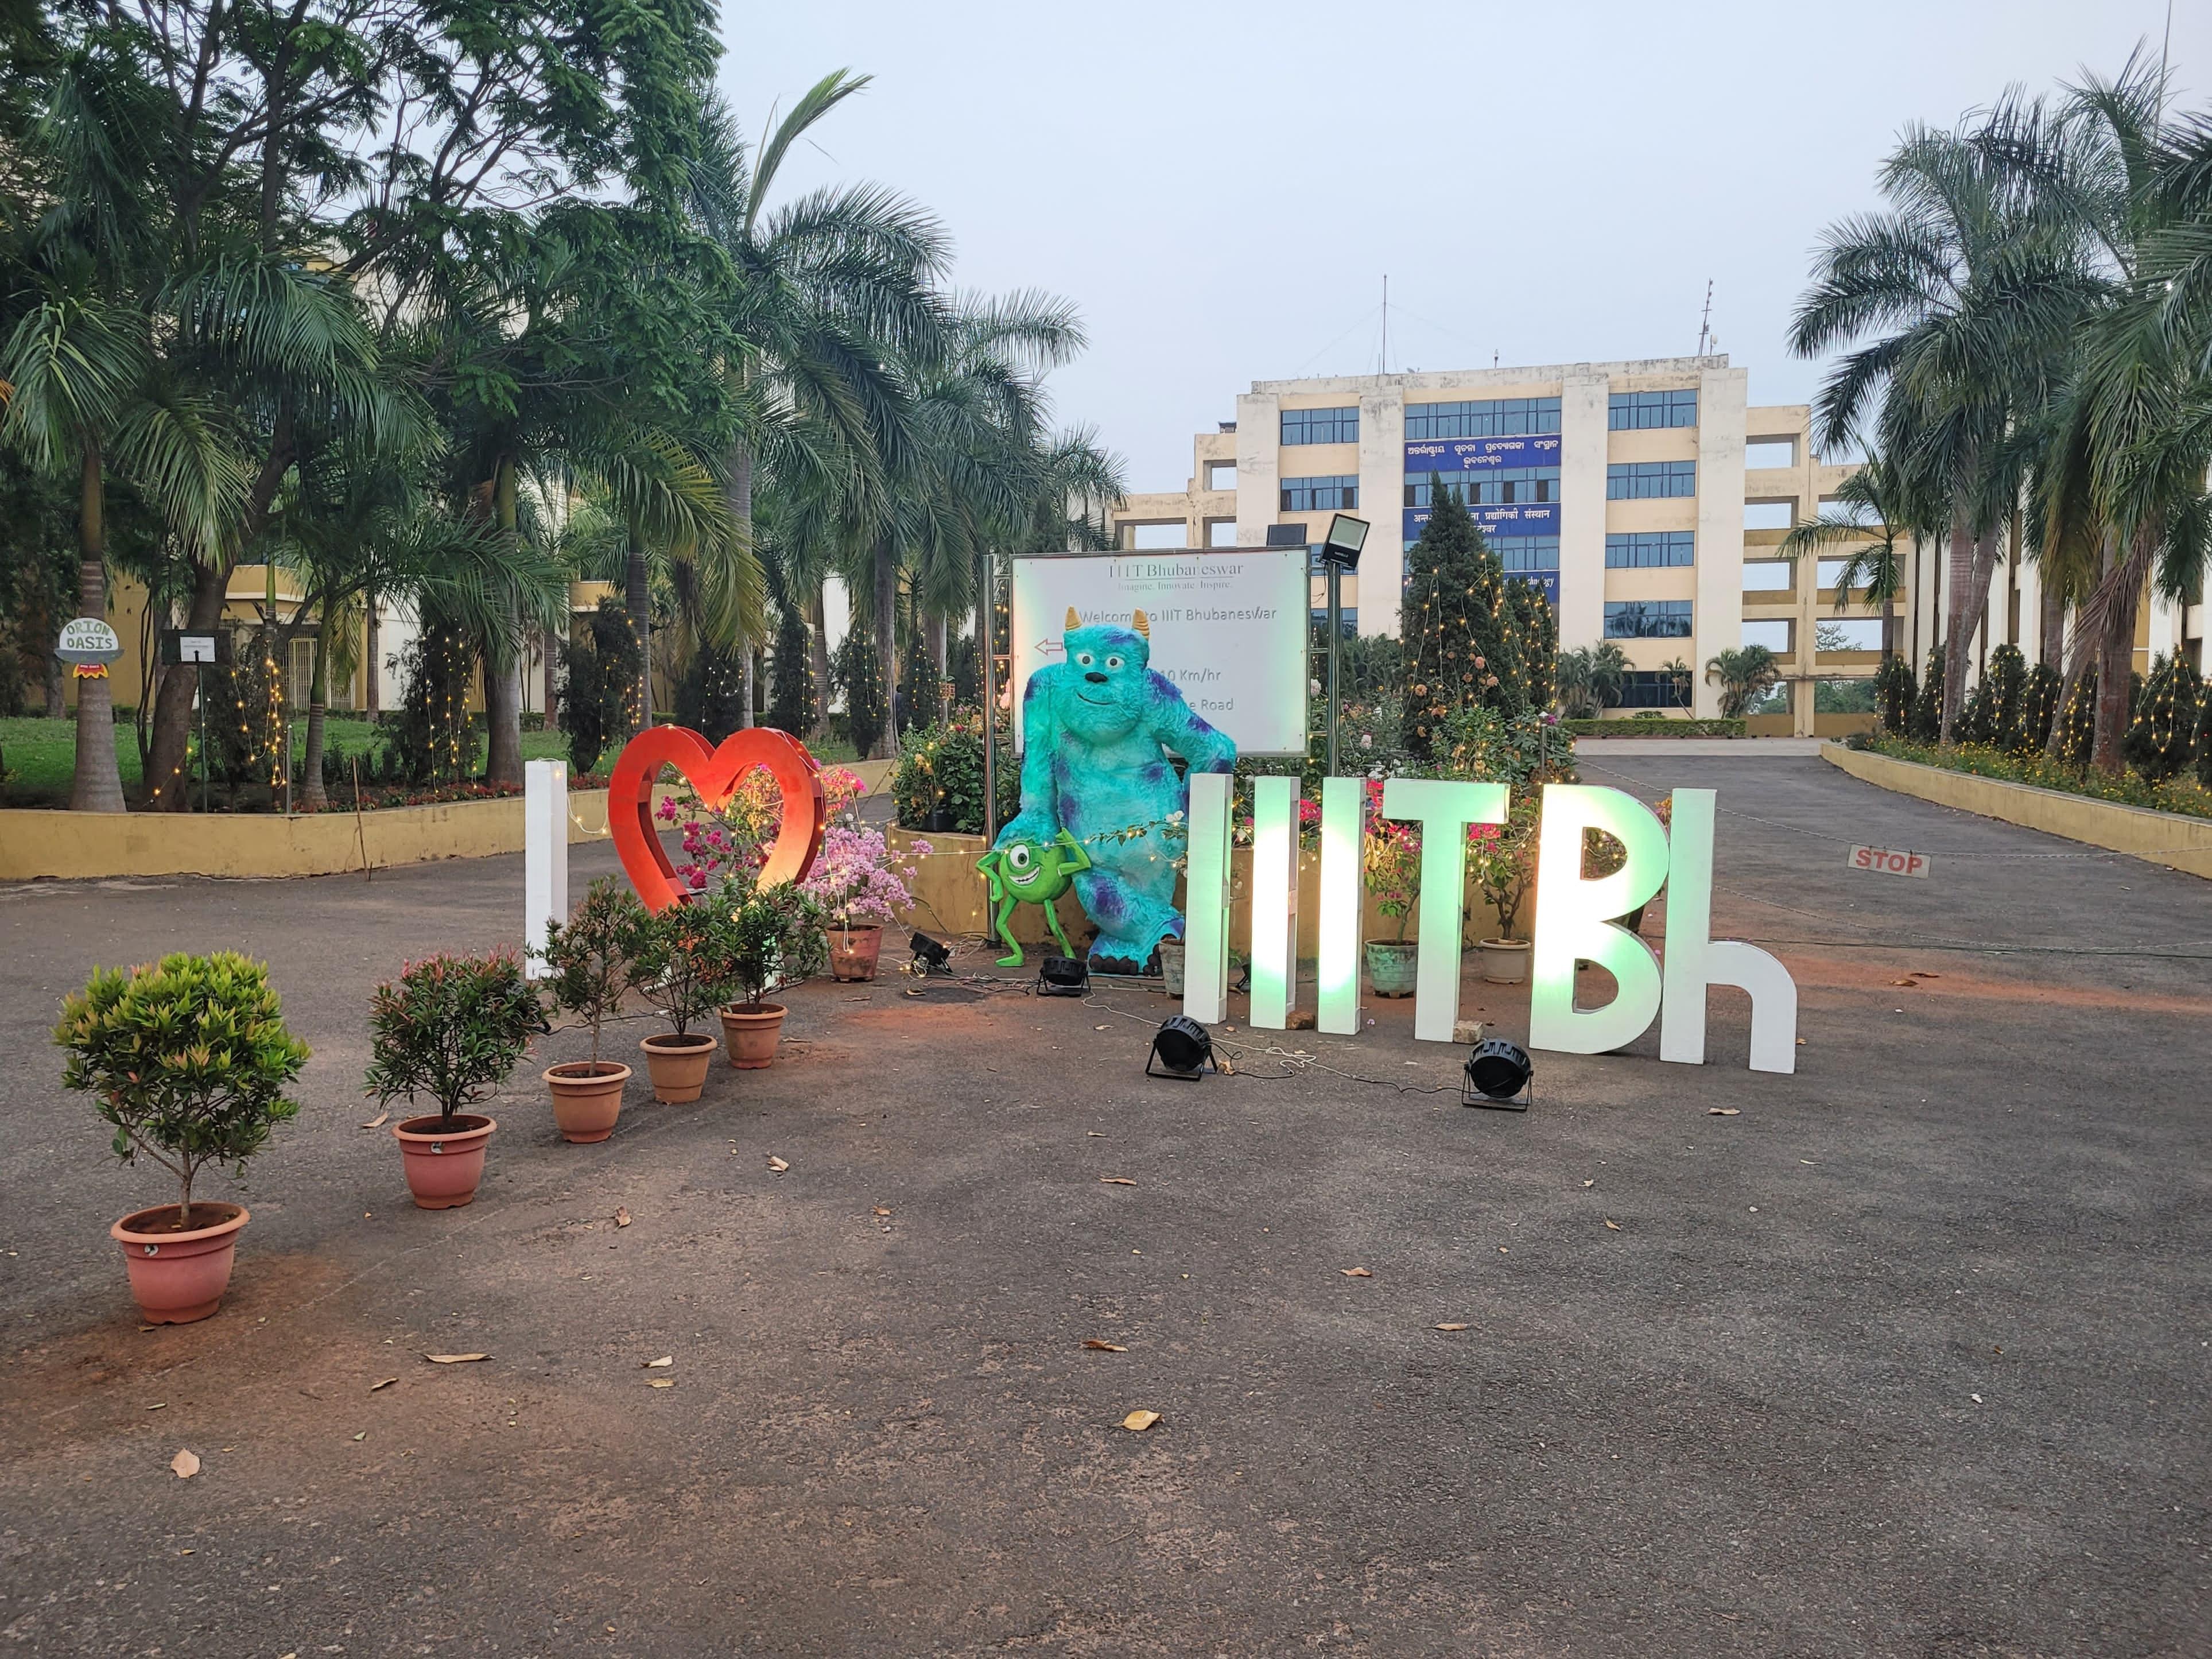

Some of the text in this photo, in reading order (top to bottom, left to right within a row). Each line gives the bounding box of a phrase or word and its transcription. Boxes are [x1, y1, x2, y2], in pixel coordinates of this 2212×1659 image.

[1524, 508, 1550, 520] संस्थान
[1079, 610, 1132, 623] Welcom
[1186, 606, 1276, 621] Bhubaneswar
[67, 621, 110, 635] ORION
[67, 637, 112, 649] OASIS
[1180, 668, 1221, 683] Km/hr
[1201, 698, 1233, 711] Road
[1856, 848, 1923, 874] STOP
